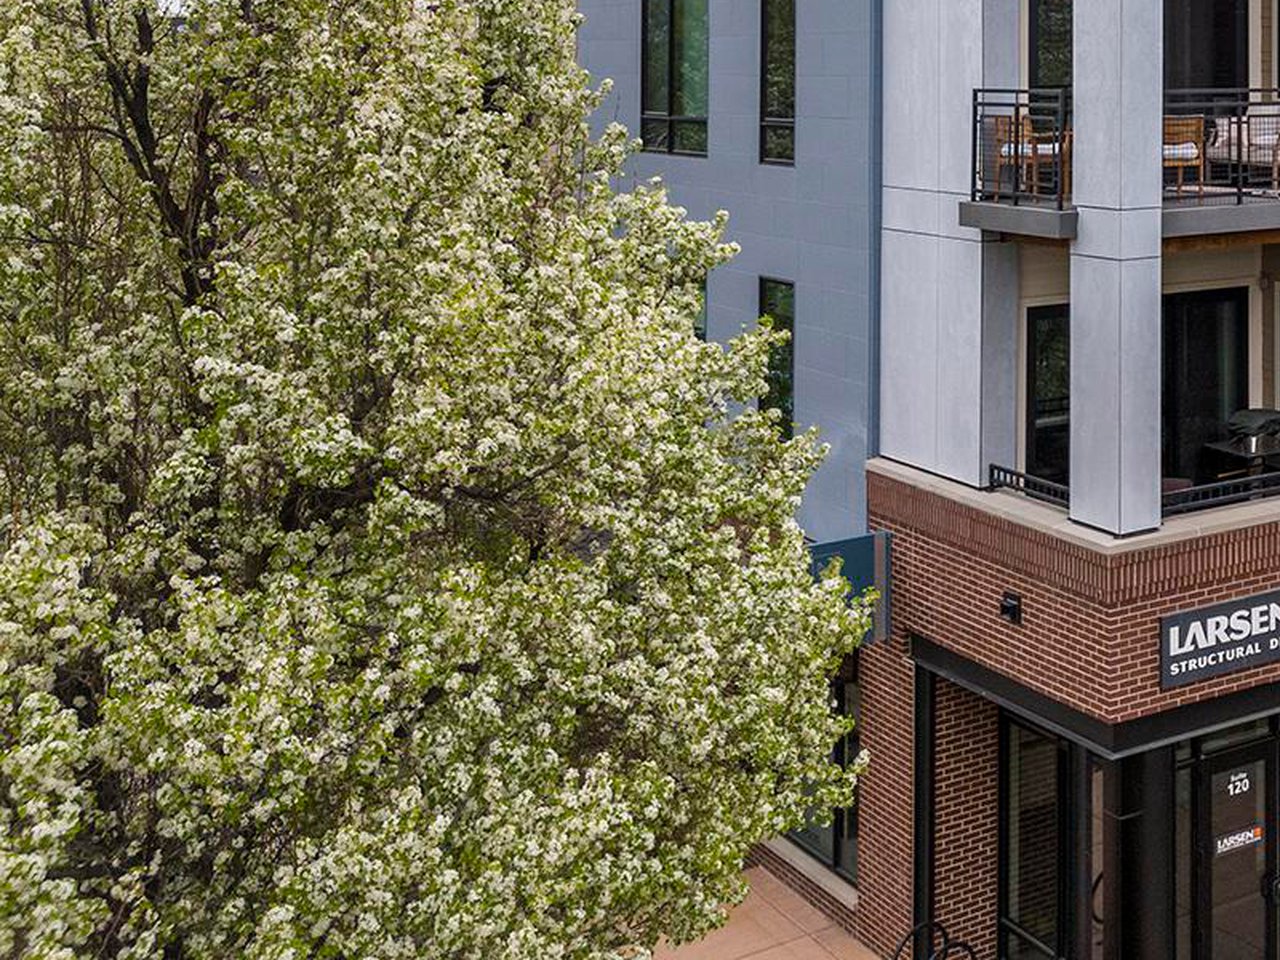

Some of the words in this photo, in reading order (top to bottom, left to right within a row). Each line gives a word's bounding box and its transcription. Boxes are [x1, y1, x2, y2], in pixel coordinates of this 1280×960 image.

[1170, 642, 1262, 676] STRUCTURAL
[1227, 778, 1250, 796] 120
[1217, 828, 1254, 849] LARSEN
